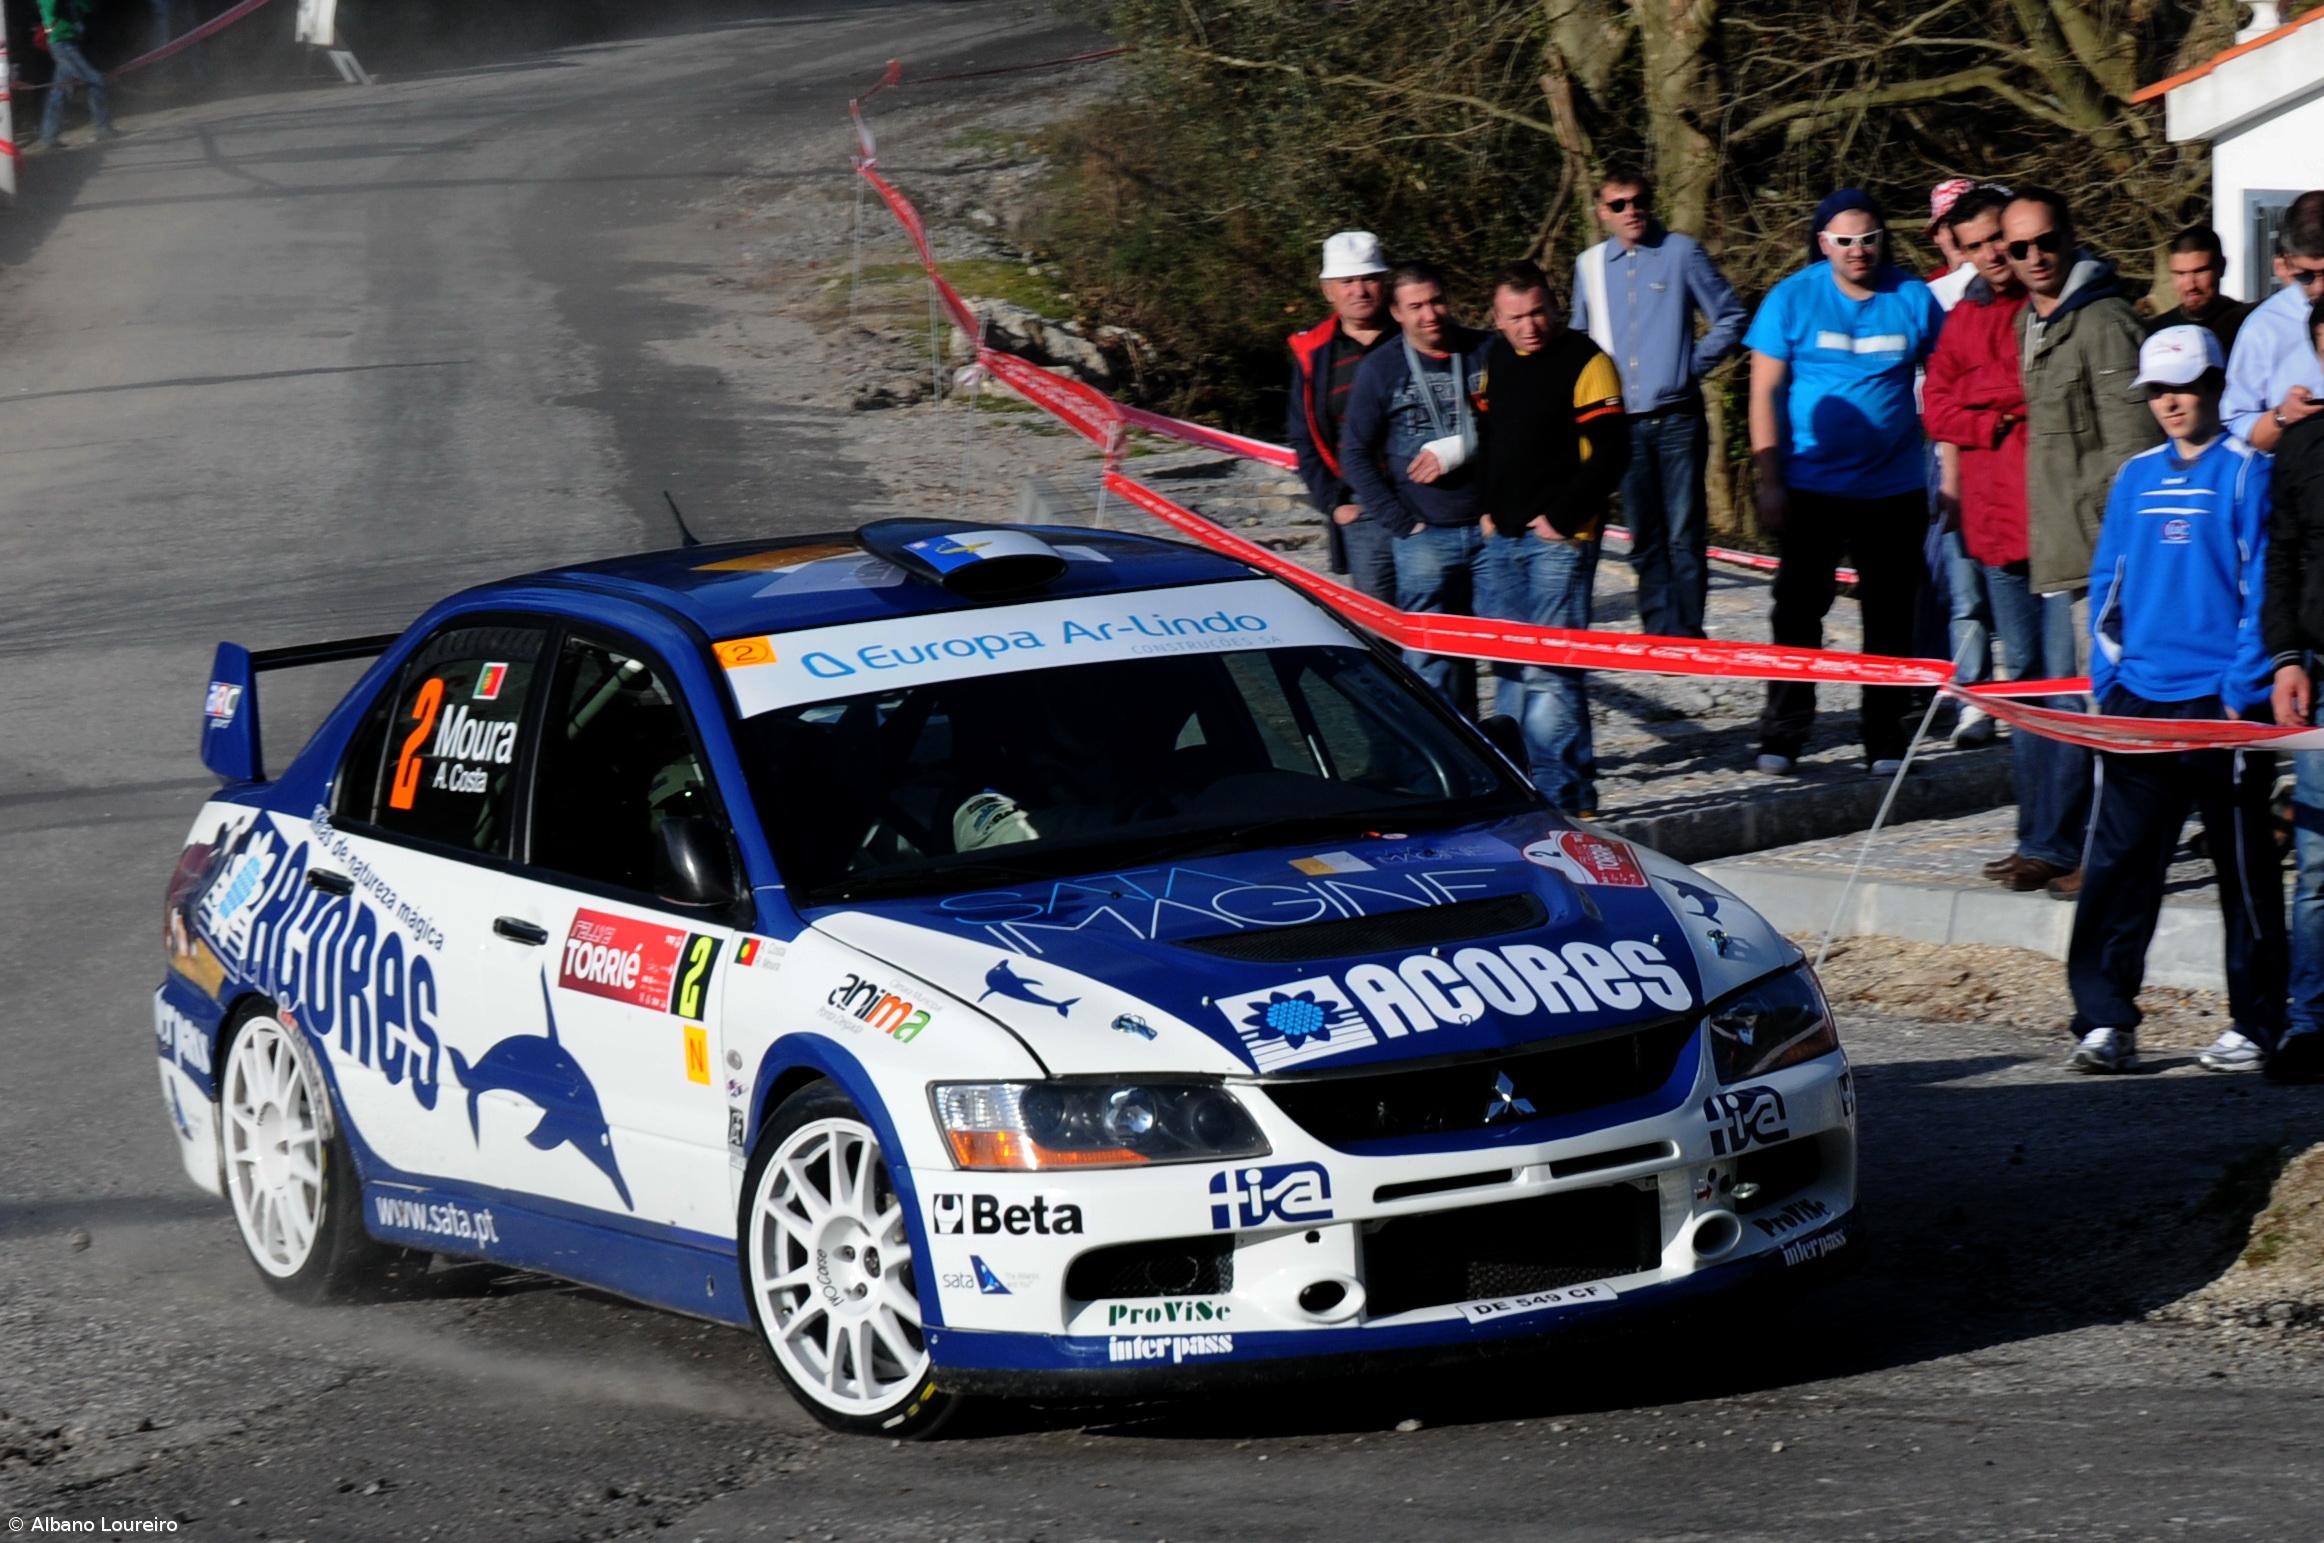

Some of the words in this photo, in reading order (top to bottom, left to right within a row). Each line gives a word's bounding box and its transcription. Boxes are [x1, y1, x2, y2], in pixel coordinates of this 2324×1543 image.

[857, 629, 1046, 670] Europa
[389, 677, 444, 810] 2
[432, 703, 519, 764] Moura
[449, 763, 488, 793] Costa
[331, 837, 350, 863] de
[348, 855, 398, 911] natureza
[396, 899, 445, 952] mágica
[678, 936, 713, 1019] 2
[827, 973, 931, 1044] anima
[689, 1038, 705, 1074] N
[375, 1196, 500, 1250] www.sata.pt
[972, 1194, 1084, 1236] Beta
[943, 1272, 975, 1289] sata
[1474, 1302, 1512, 1316] DE
[1516, 1293, 1563, 1308] 549
[1567, 1286, 1601, 1299] CF
